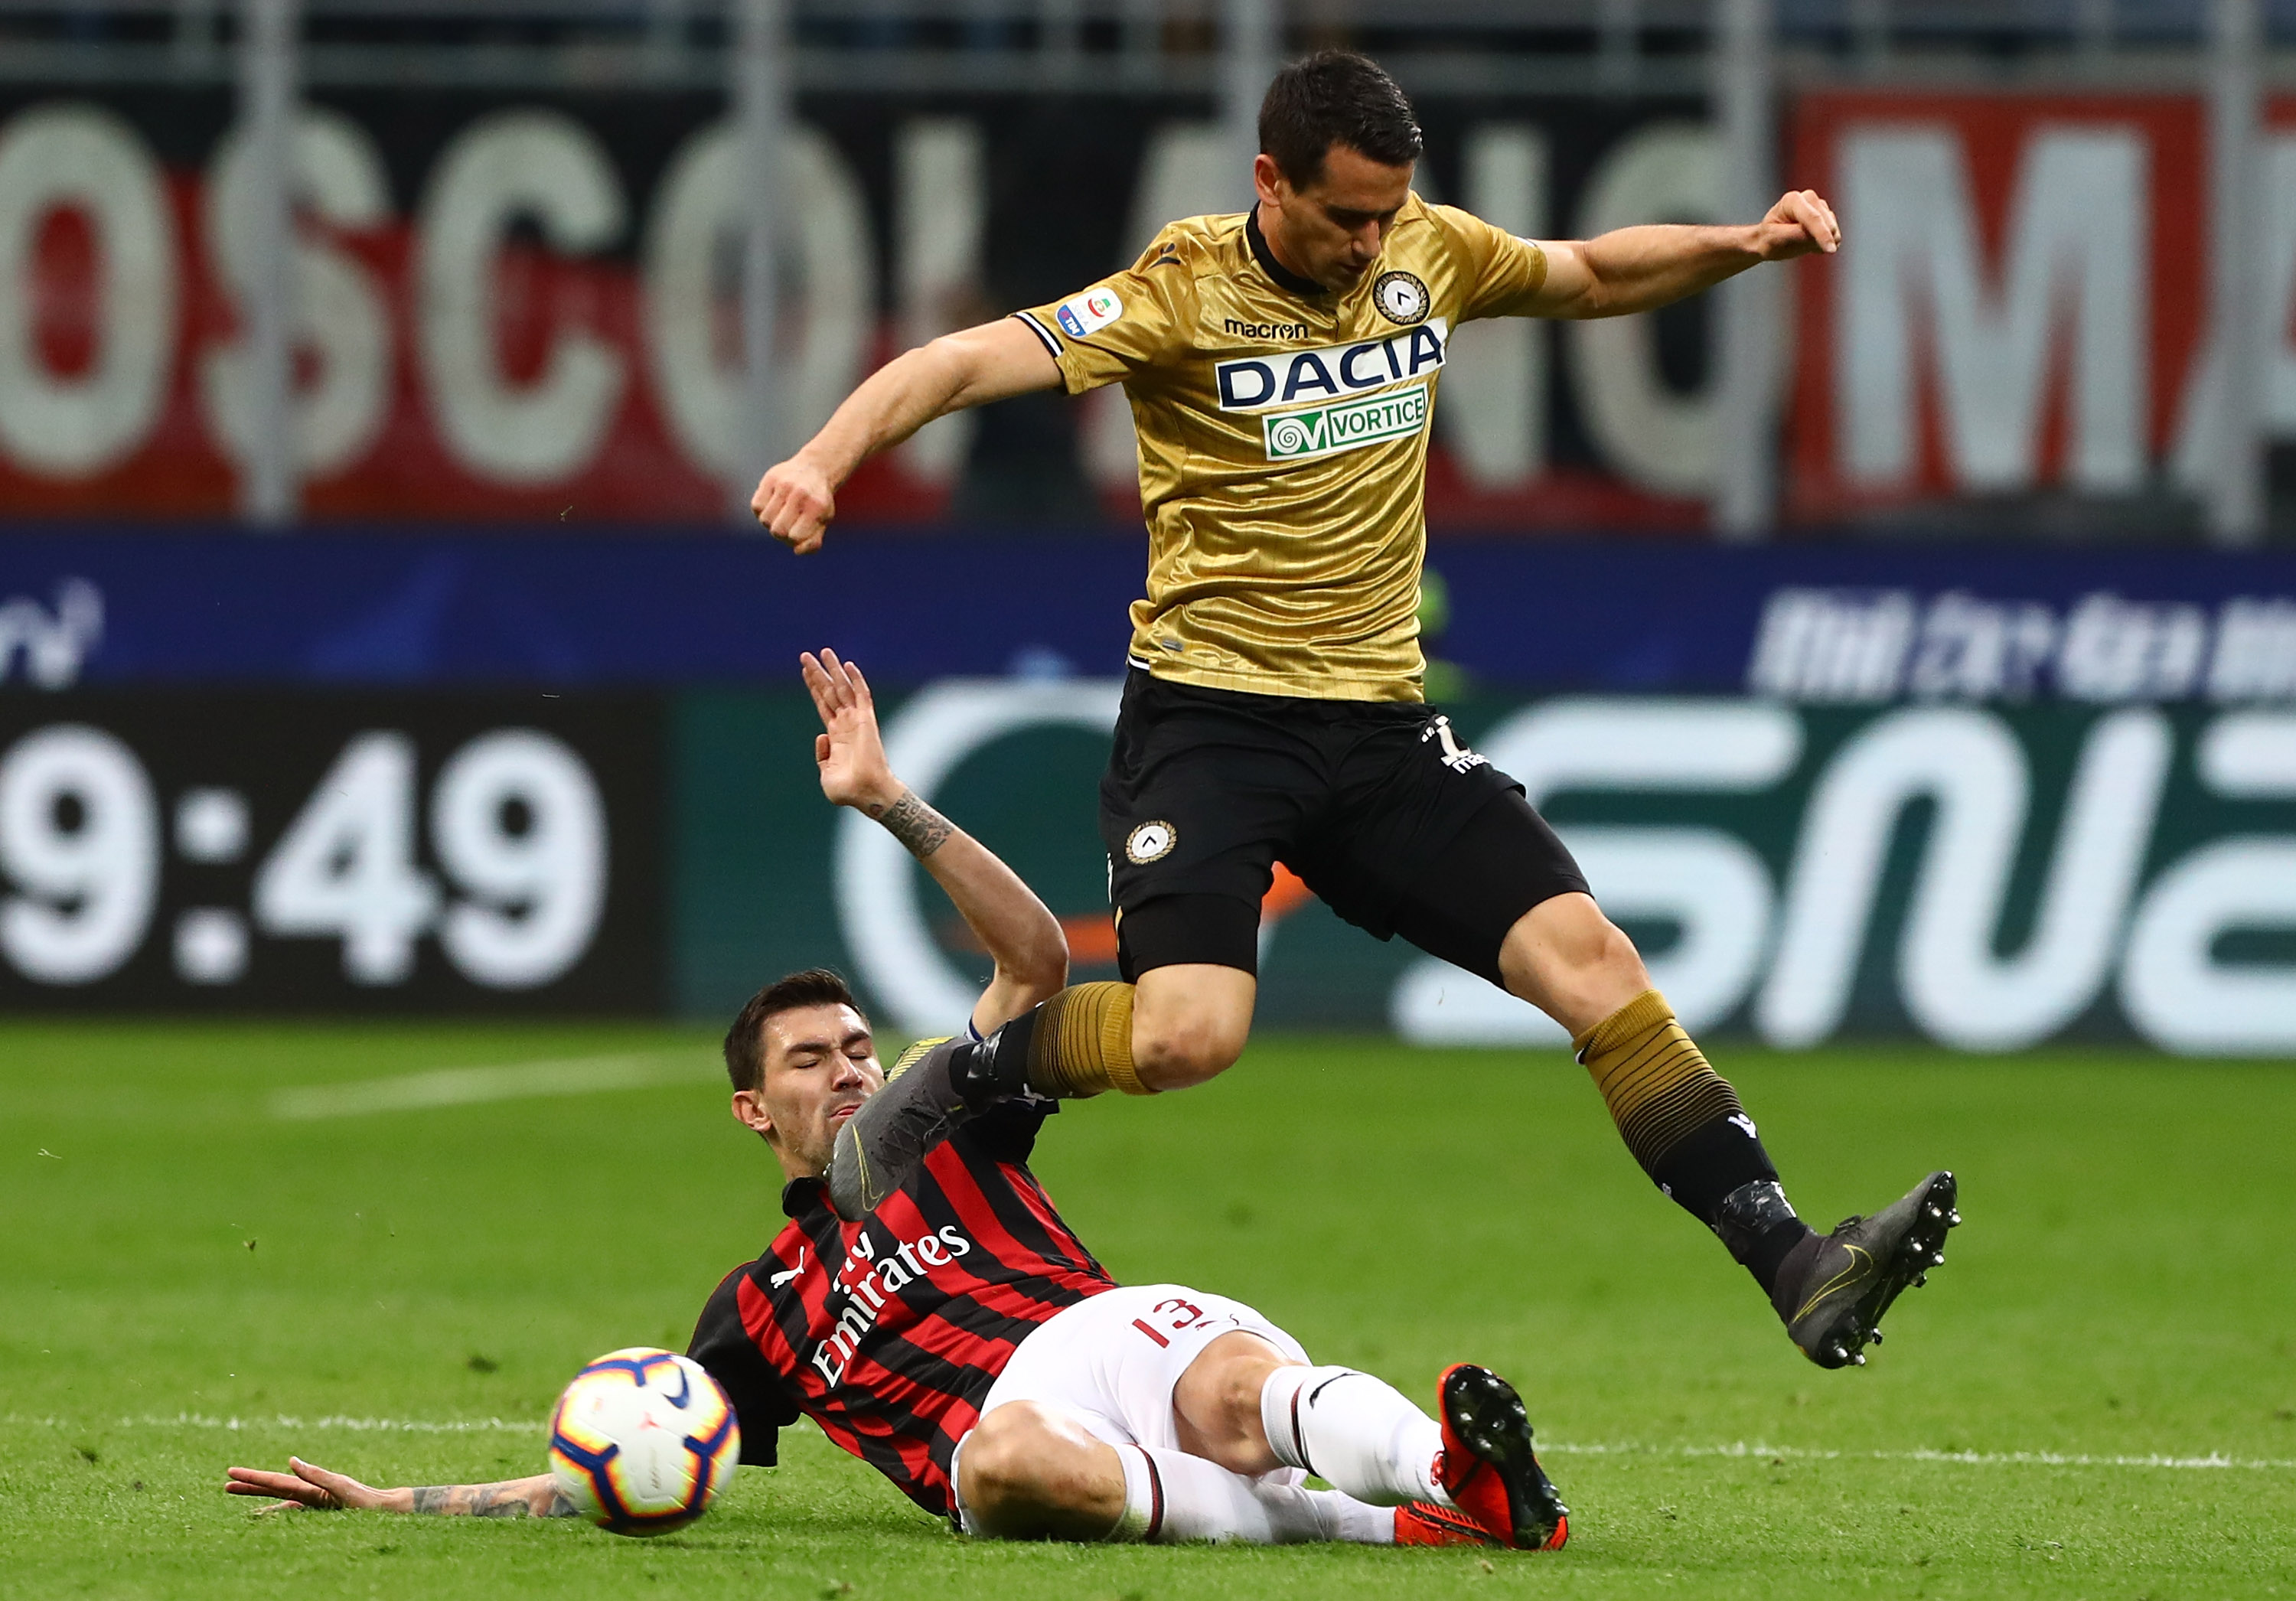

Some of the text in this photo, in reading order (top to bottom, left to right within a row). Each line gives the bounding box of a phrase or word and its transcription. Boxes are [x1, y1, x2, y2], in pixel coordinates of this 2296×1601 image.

[1065, 316, 1081, 334] TIM
[1225, 318, 1309, 340] macron
[1218, 324, 1443, 407] DACIA
[1332, 396, 1424, 437] VORTICE
[812, 1225, 970, 1388] Emirates
[1132, 1299, 1204, 1348] 13
